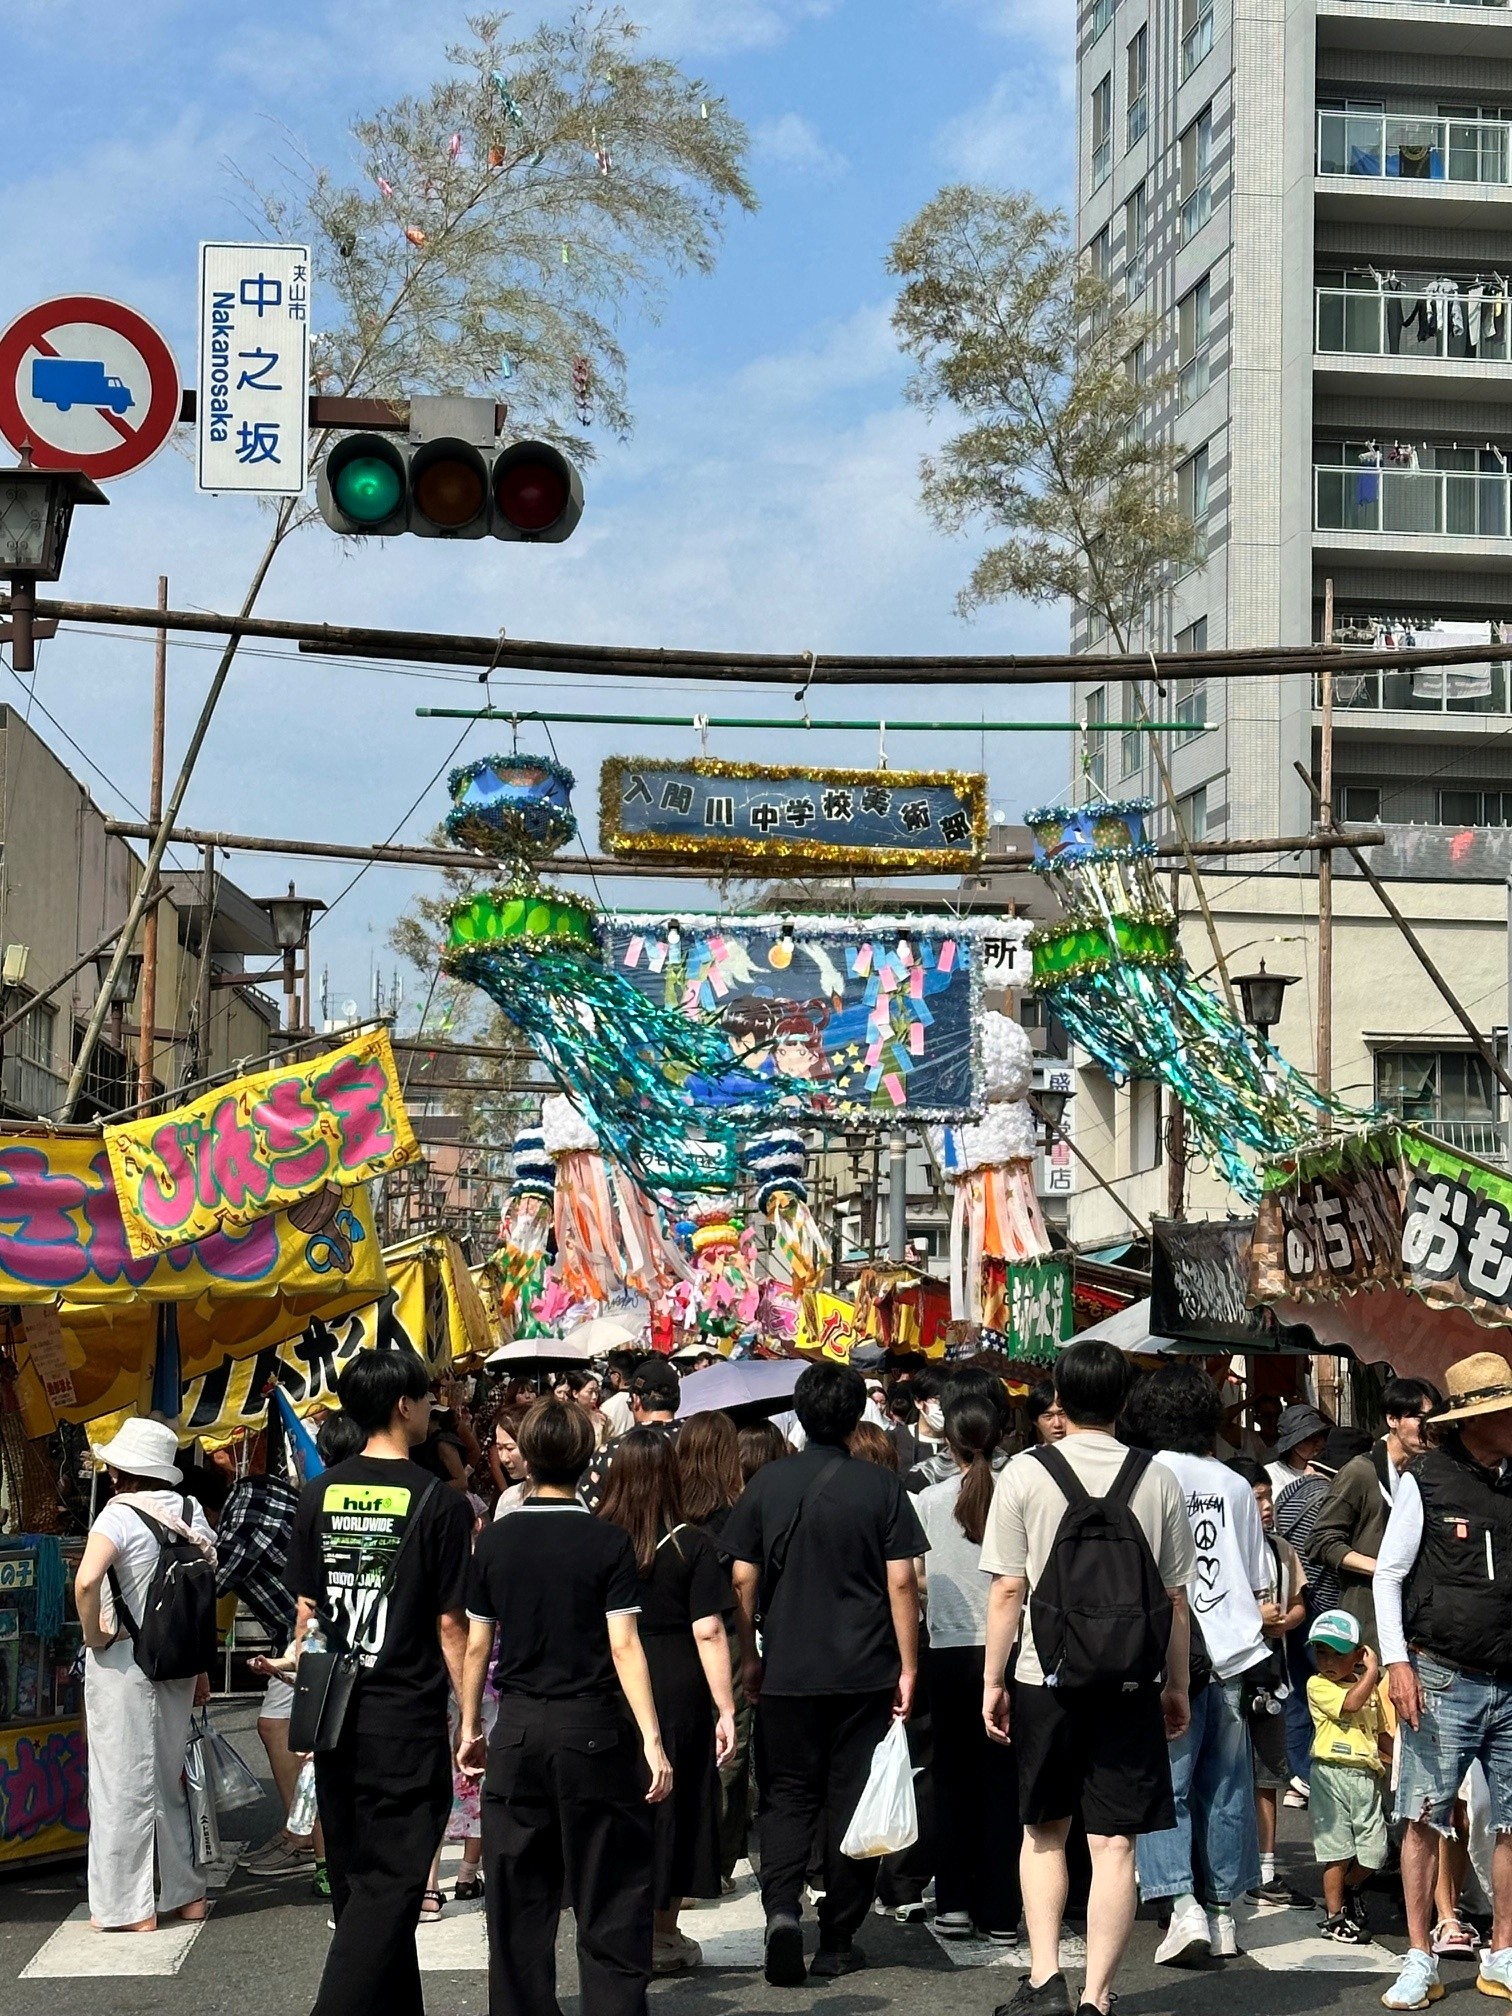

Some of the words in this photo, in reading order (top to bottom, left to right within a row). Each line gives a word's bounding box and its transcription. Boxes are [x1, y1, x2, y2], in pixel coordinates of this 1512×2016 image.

[210, 292, 236, 442] Nakanosaka
[235, 272, 282, 464] 中之坂
[622, 775, 973, 845] 入間川中学校美術部
[984, 937, 1017, 969] 所
[1402, 1183, 1512, 1297] おも
[331, 1516, 394, 1532] WORLDWIDE
[343, 1497, 382, 1512] huf
[1, 1561, 32, 1586] の子
